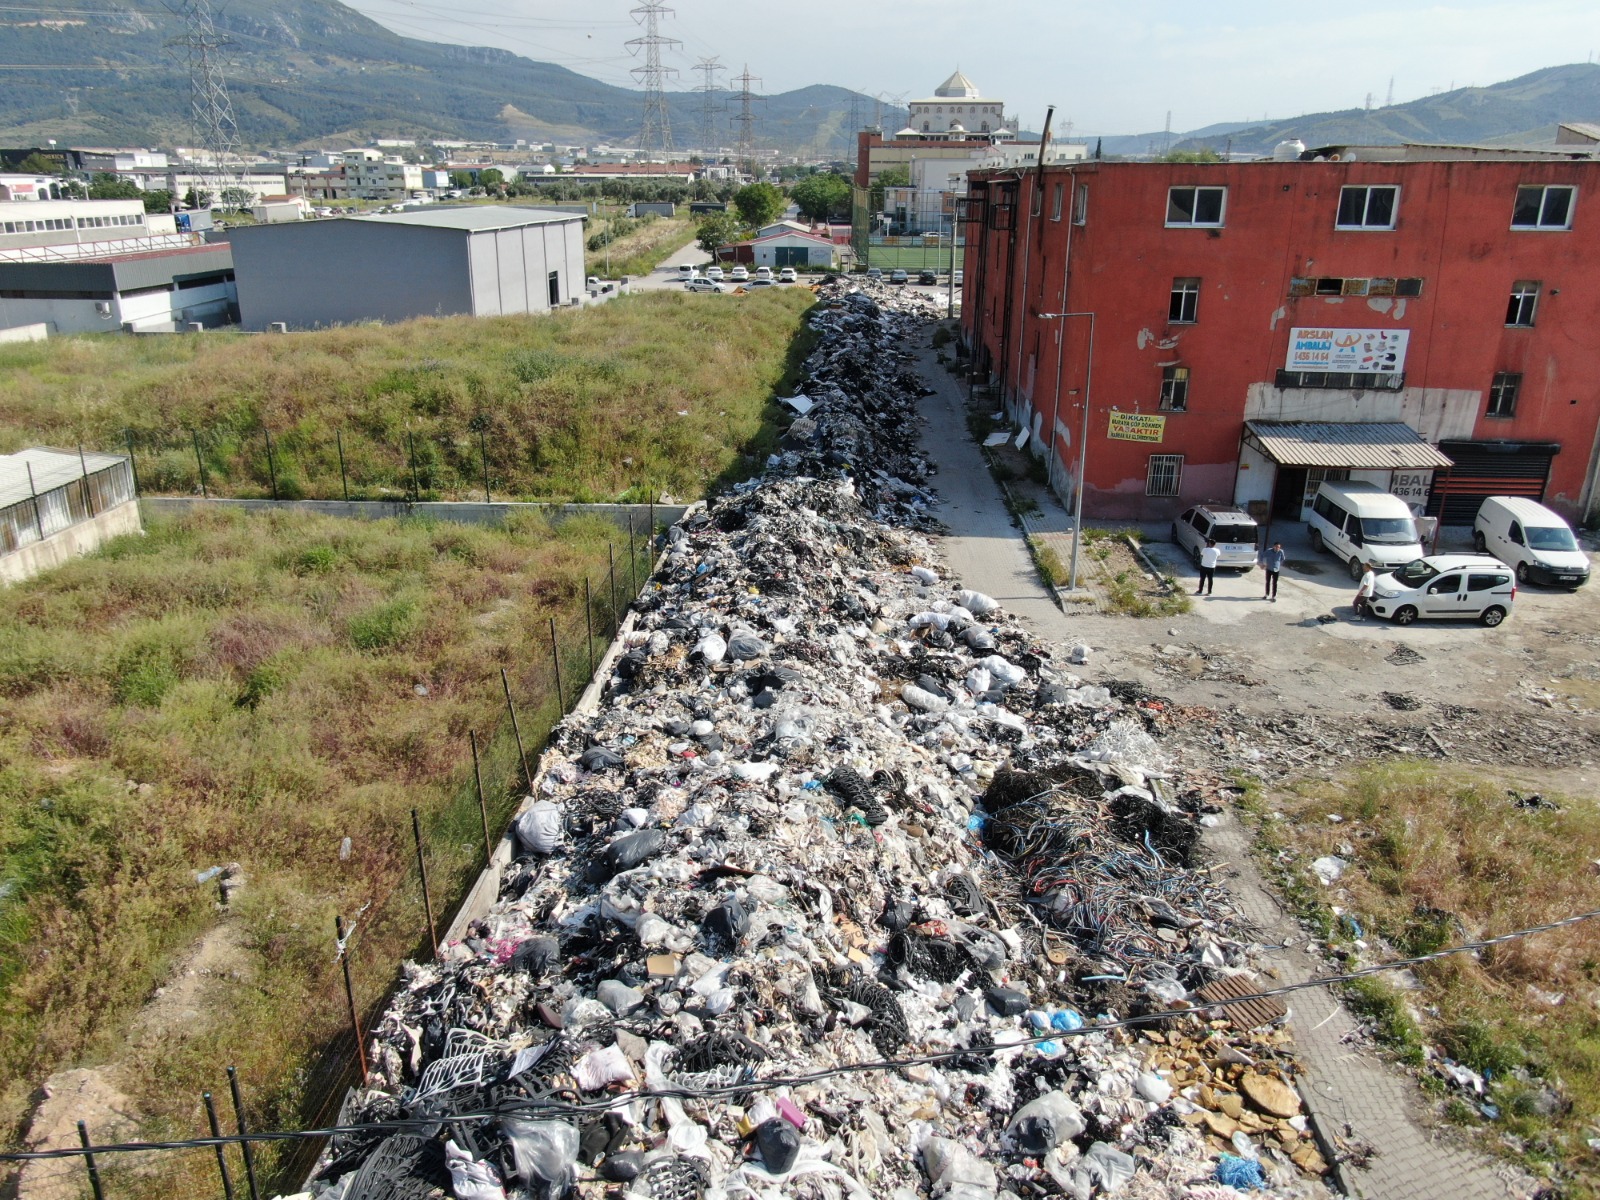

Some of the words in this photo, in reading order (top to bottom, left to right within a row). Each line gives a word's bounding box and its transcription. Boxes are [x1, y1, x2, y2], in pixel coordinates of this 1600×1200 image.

[1297, 330, 1334, 339] ARSLAN
[1295, 341, 1332, 350] AMBALAJ
[1113, 425, 1159, 435] YASAKTIR
[1393, 488, 1410, 496] 436
[1412, 488, 1422, 496] 14
